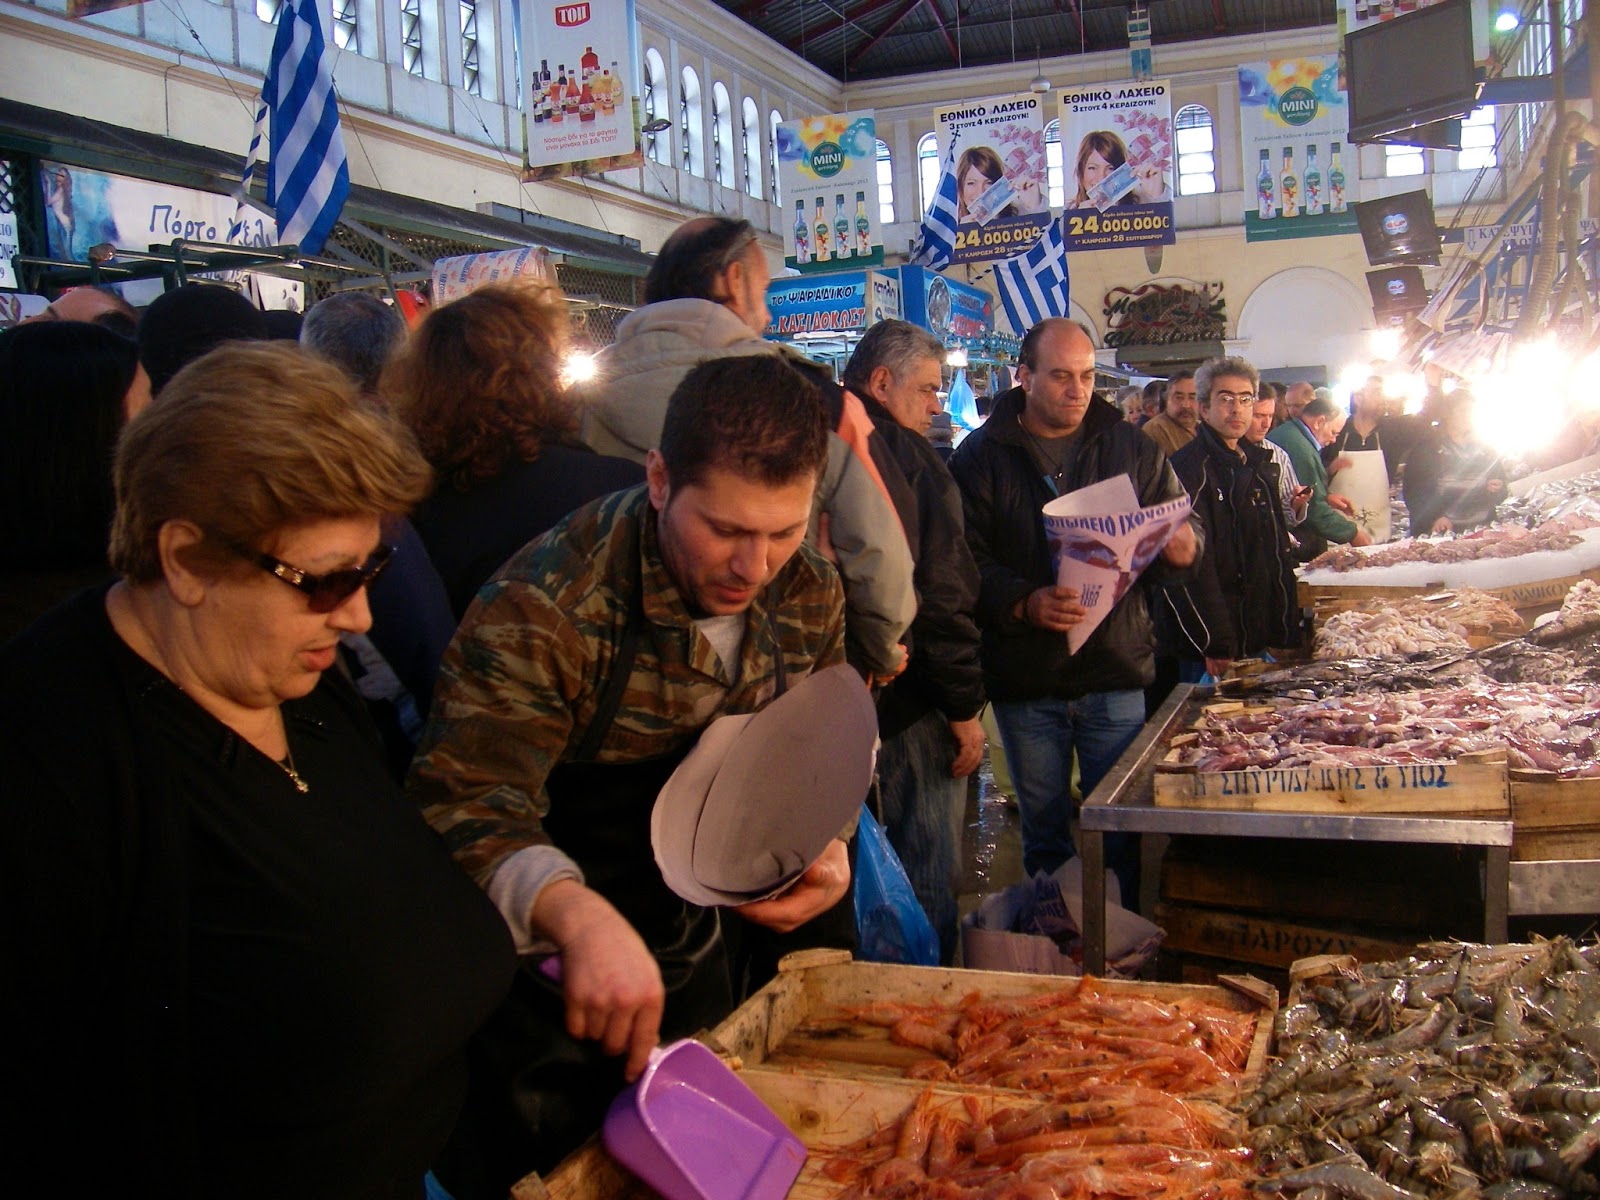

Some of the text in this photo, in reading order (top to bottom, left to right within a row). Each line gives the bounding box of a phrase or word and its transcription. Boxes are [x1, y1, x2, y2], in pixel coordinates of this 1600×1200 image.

[558, 6, 587, 24] ΤΟΠ
[1063, 85, 1165, 104] ΕΘΝΙΚΟ ΛΑΧΕΙΟ
[940, 99, 1037, 123] ΕΘΝΙΚΟ ΛΑΧΕΙΟ
[1101, 102, 1108, 110] 4
[1282, 99, 1314, 112] MINI
[949, 122, 956, 130] 3
[977, 118, 983, 127] 4
[813, 152, 842, 166] MINI
[150, 205, 216, 241] Πόρτο
[1069, 216, 1169, 235] 24.000.000€
[955, 226, 1043, 249] 24.000.000
[1112, 234, 1125, 242] 28
[994, 246, 1006, 254] 28
[771, 285, 854, 306] ΤΟ ΨΑΡΑΔΙΚΟ
[1045, 515, 1117, 537] ΟΠΩΛΕΙΟ
